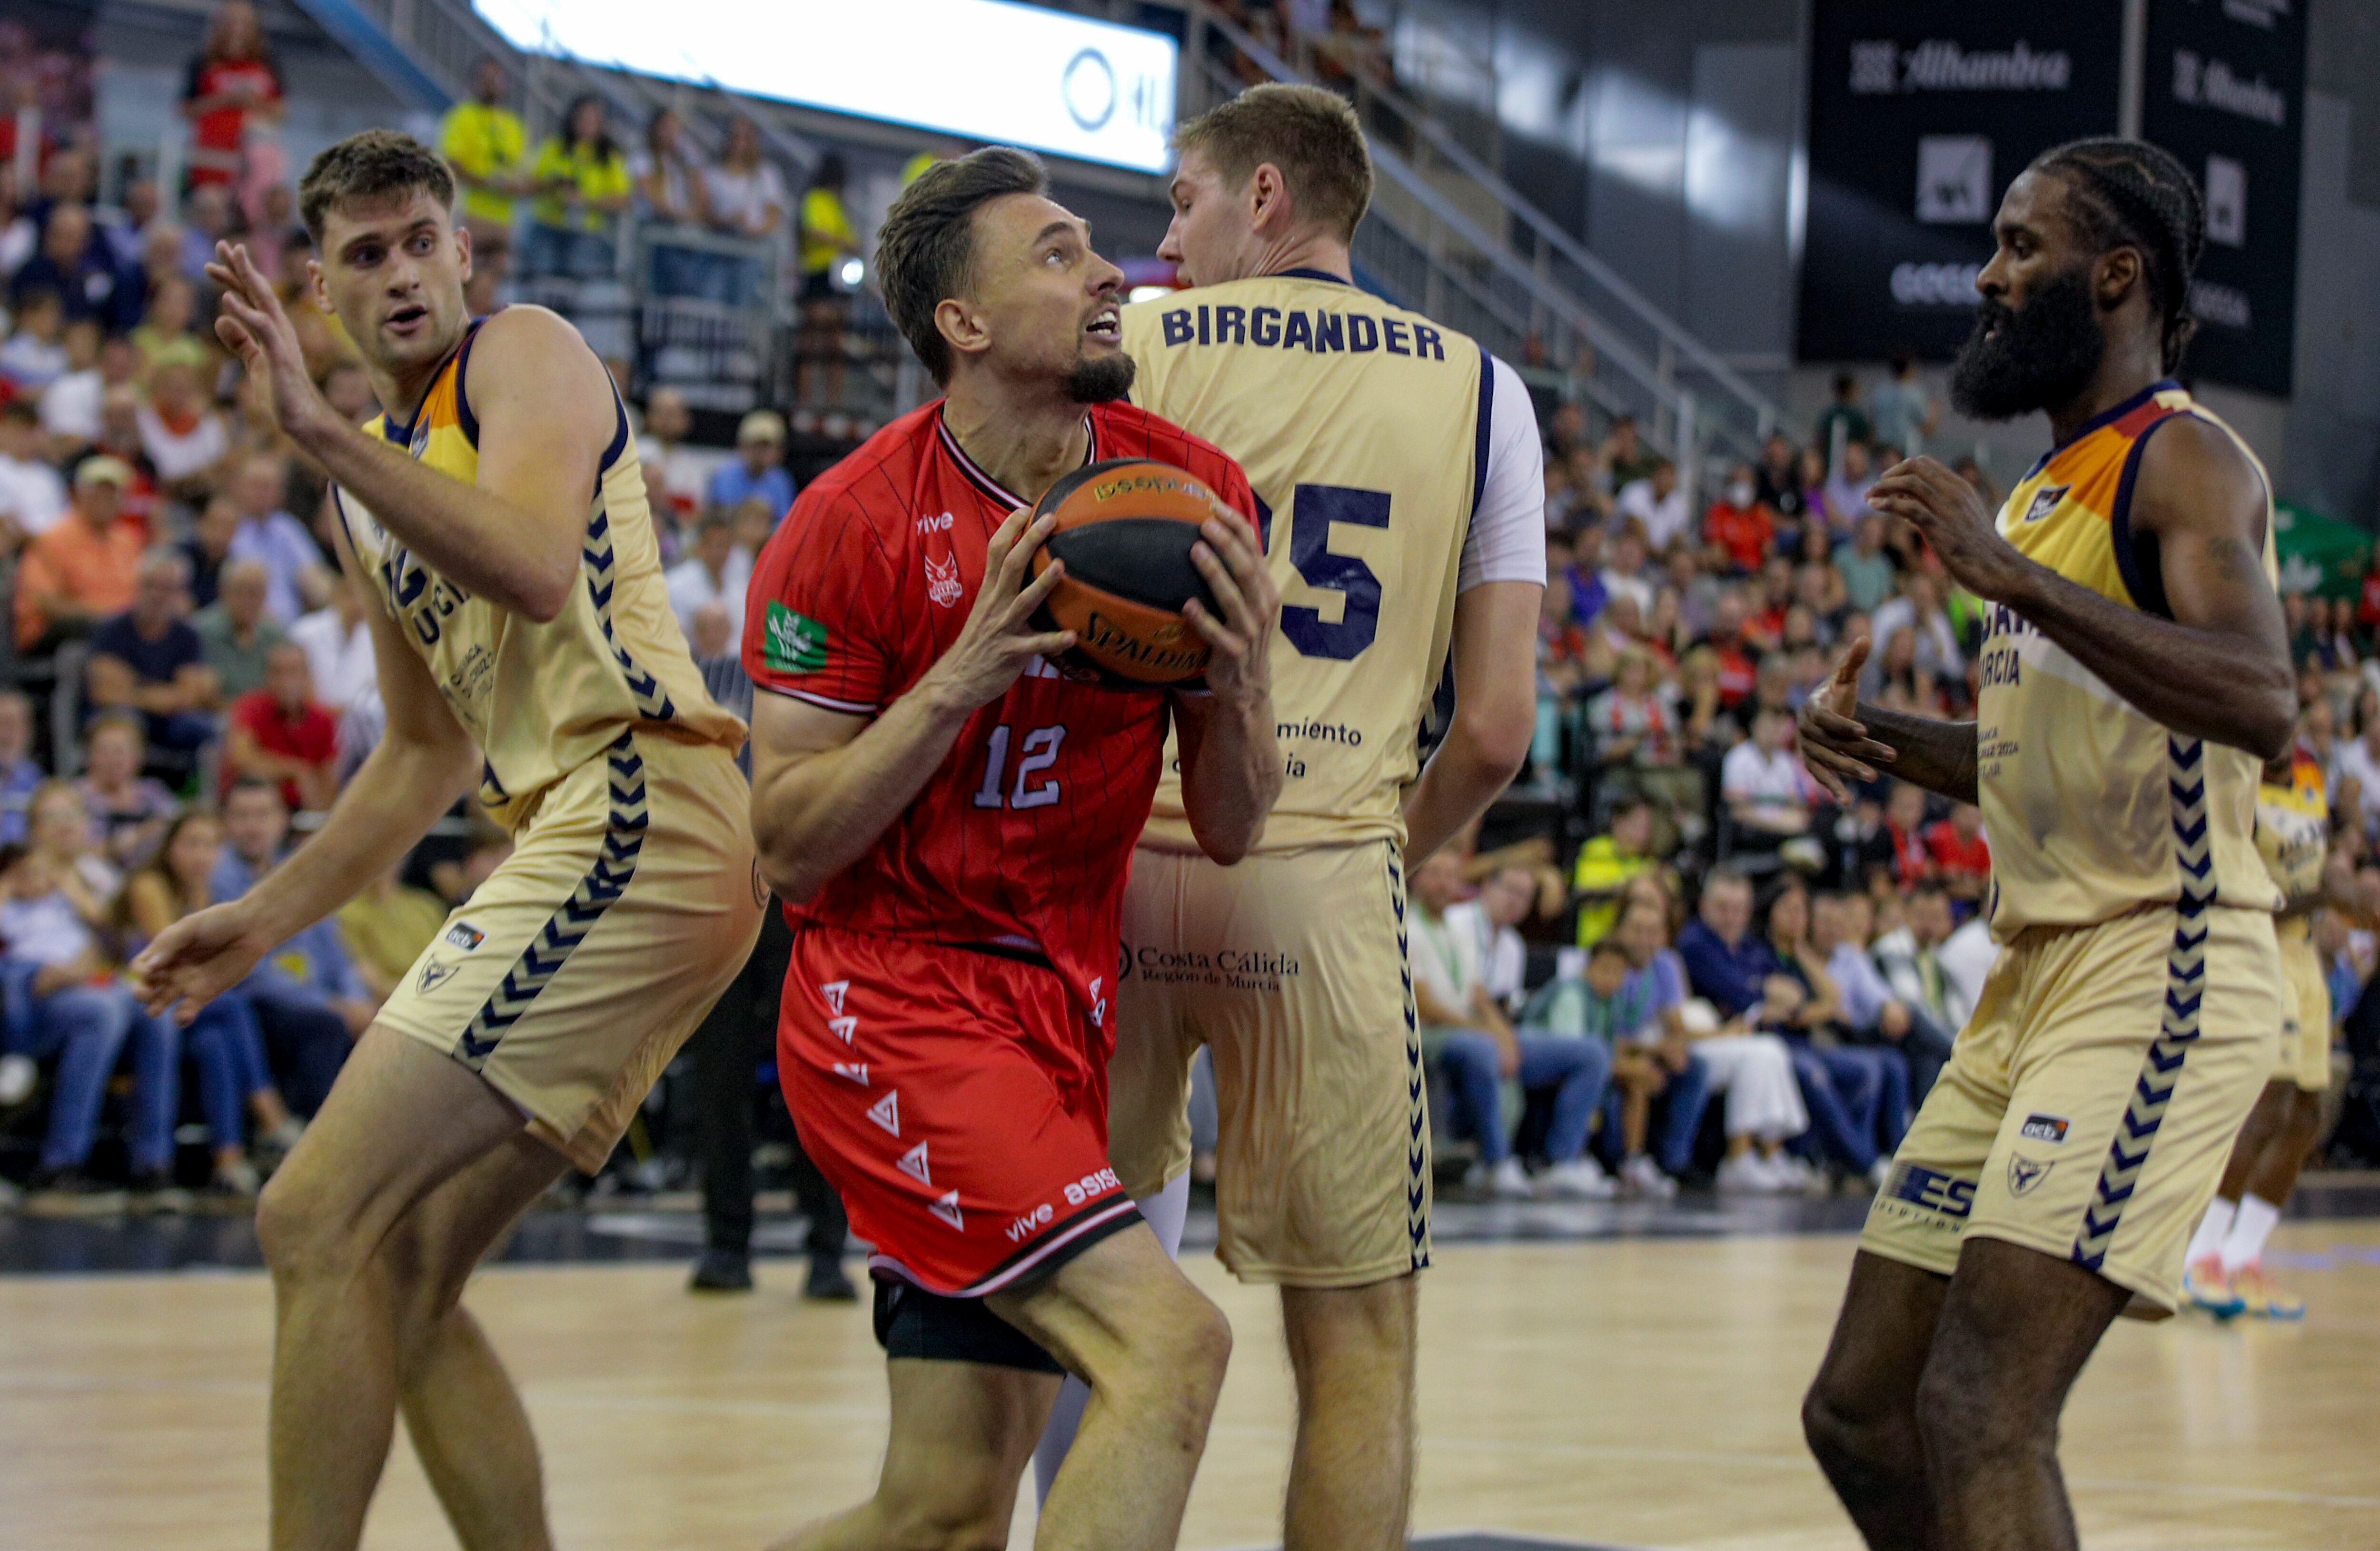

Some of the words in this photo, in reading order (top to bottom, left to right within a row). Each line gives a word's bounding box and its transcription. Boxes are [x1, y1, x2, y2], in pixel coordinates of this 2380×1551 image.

[1161, 305, 1445, 362] BIRGANDER
[1277, 717, 1363, 746] miento
[974, 723, 1068, 809] 12
[1138, 946, 1209, 969] Costa
[1217, 950, 1299, 976] Cálida
[1204, 971, 1221, 985] de
[1226, 974, 1280, 991] Murcia
[1005, 1203, 1053, 1243] vive
